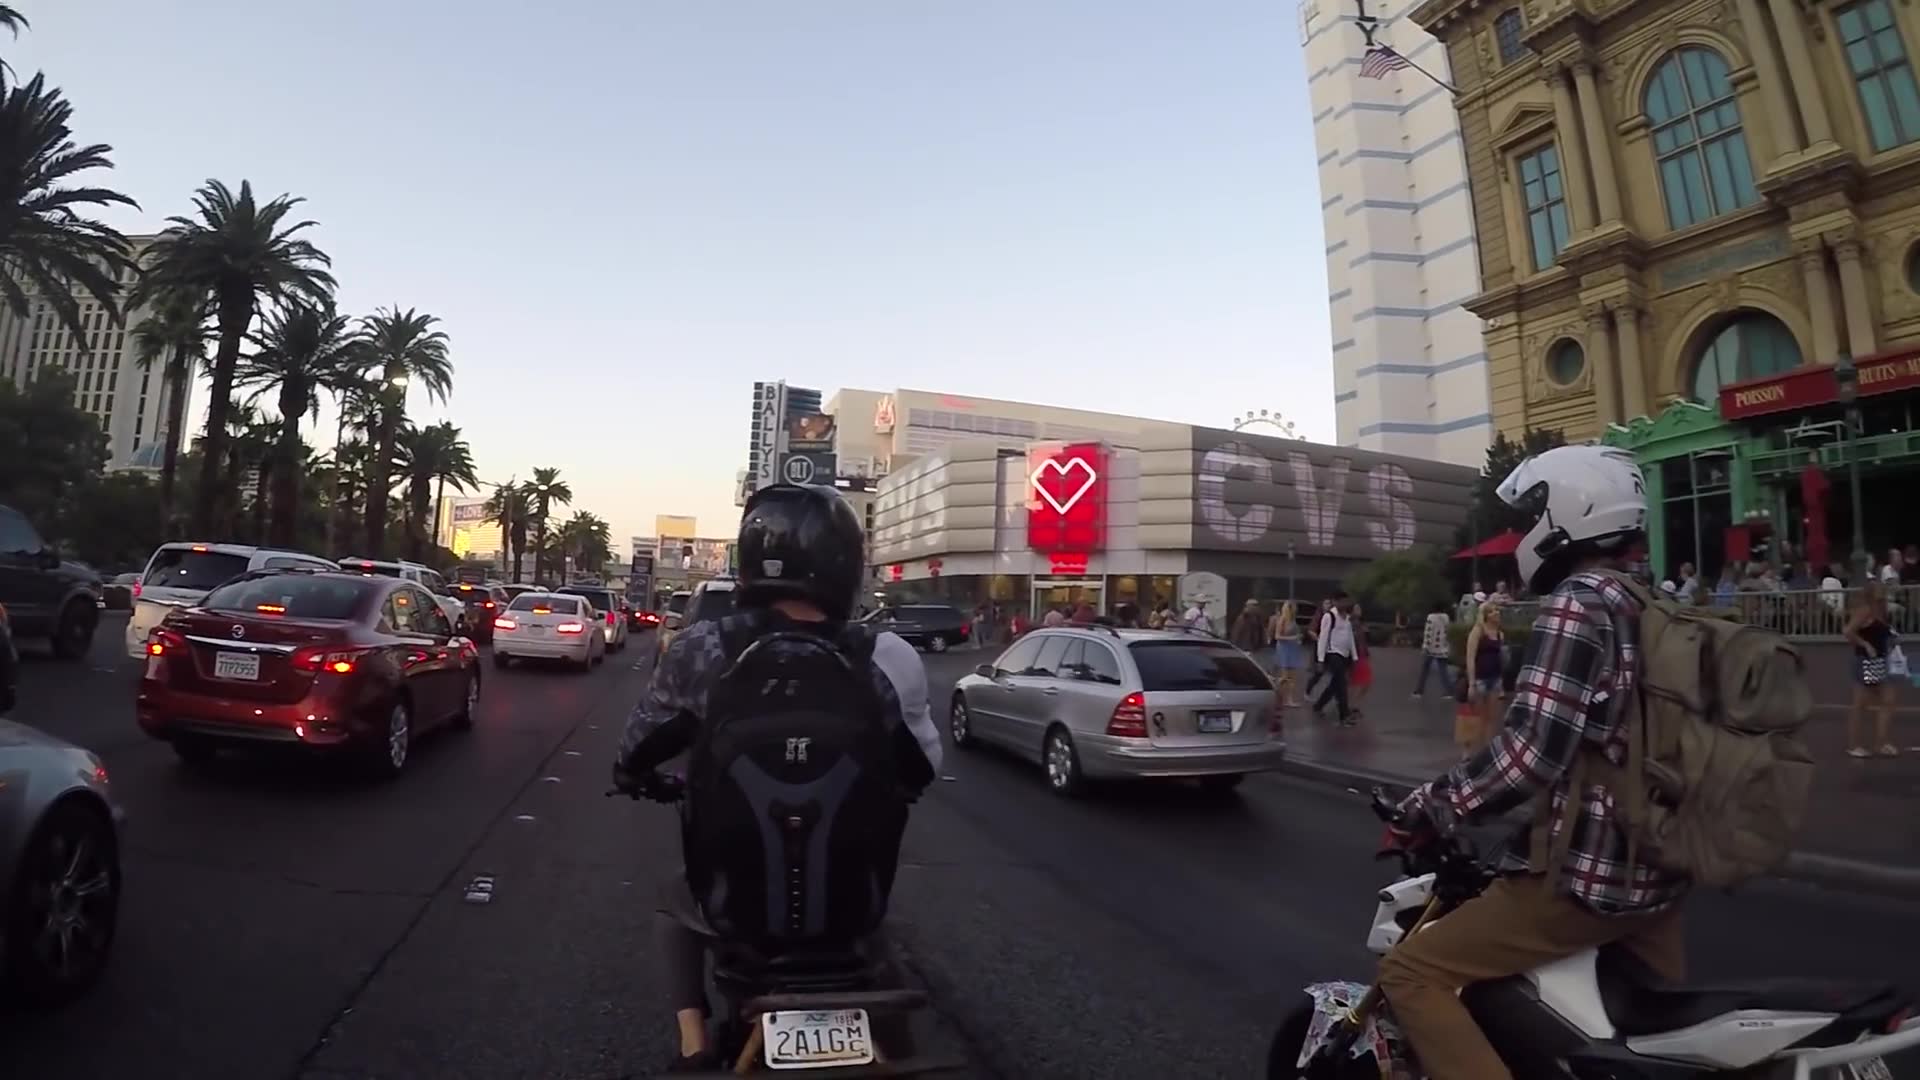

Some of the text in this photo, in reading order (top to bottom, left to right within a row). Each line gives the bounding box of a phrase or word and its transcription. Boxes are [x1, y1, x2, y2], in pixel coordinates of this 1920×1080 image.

[1858, 363, 1896, 384] RUITS
[1736, 385, 1785, 408] POISSON
[790, 461, 808, 479] BLT
[1198, 441, 1417, 551] CVS
[776, 1027, 845, 1057] 2A1G
